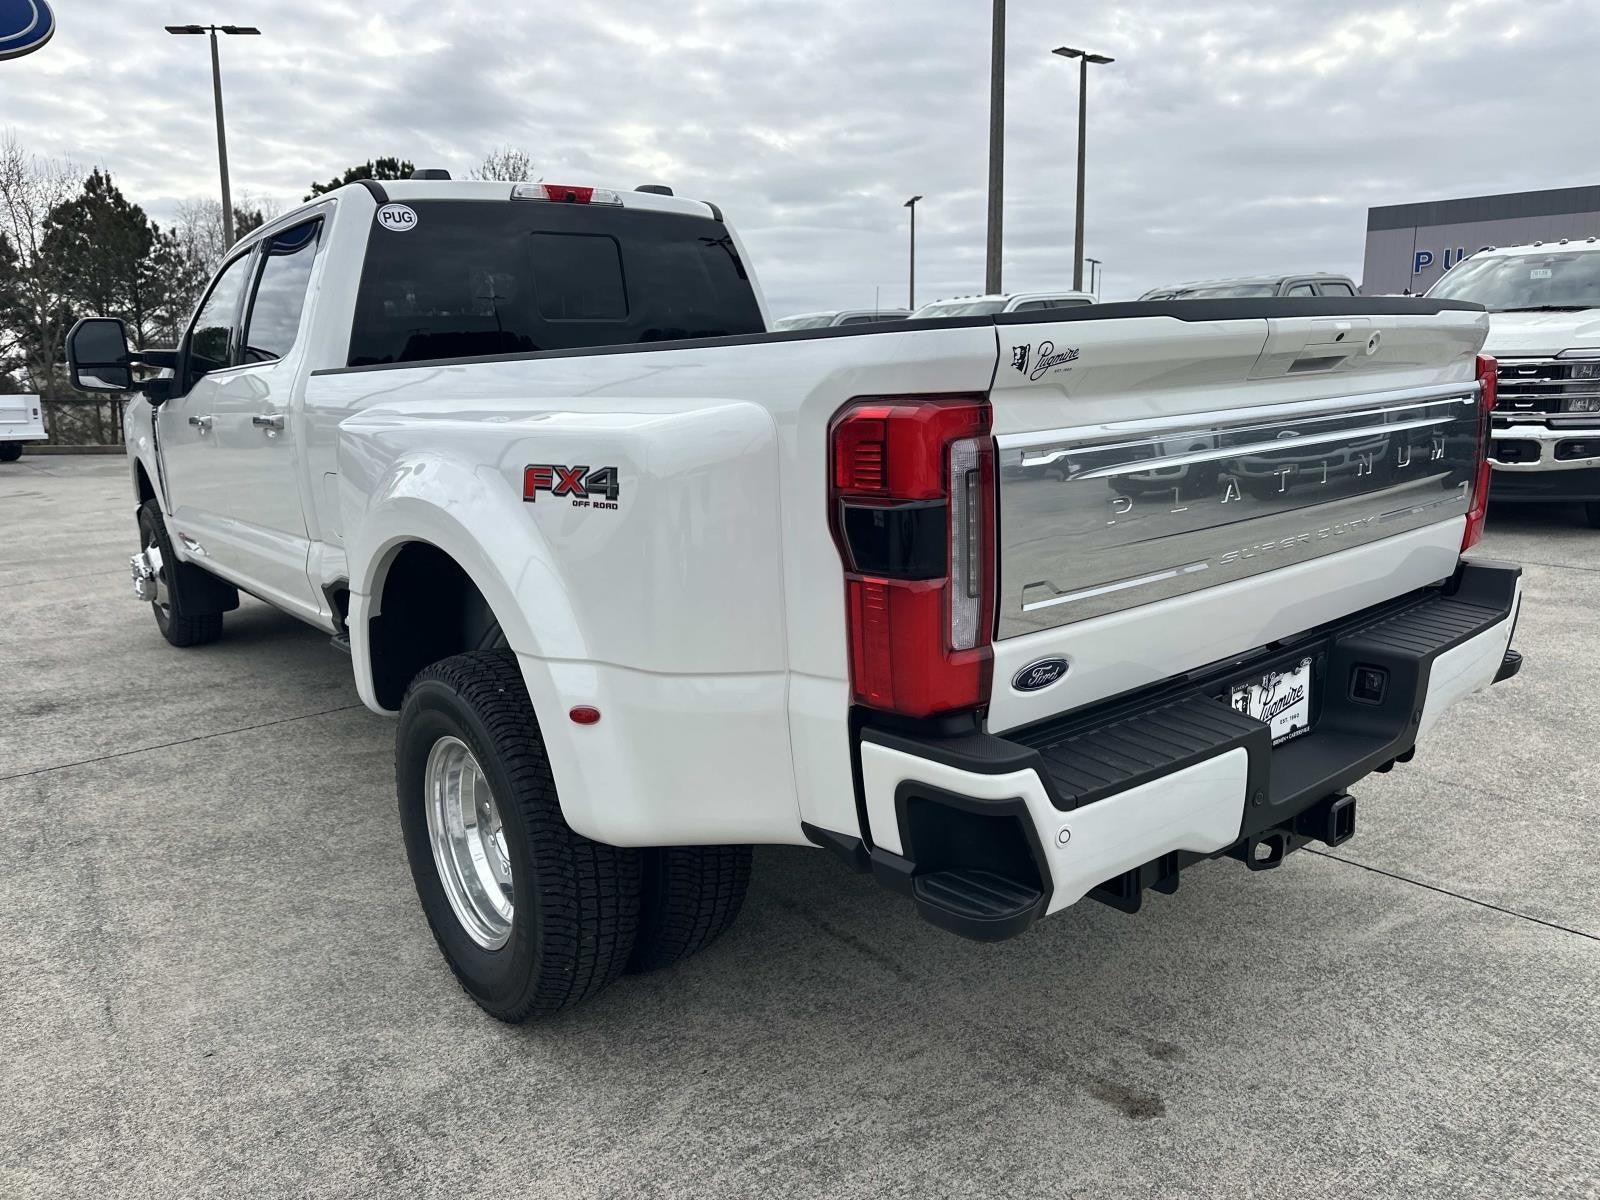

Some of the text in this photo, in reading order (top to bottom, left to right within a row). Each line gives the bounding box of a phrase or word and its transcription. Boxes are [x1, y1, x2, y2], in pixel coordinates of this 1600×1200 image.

[382, 211, 413, 223] PUG
[1030, 340, 1080, 381] Pugmire
[523, 464, 619, 503] FX4
[1106, 438, 1446, 526] PLATINUM
[572, 500, 618, 510] OFF ROAD
[1220, 516, 1375, 565] SUPER DUTY
[1028, 665, 1060, 686] Ford
[1259, 680, 1305, 726] Pugmire
